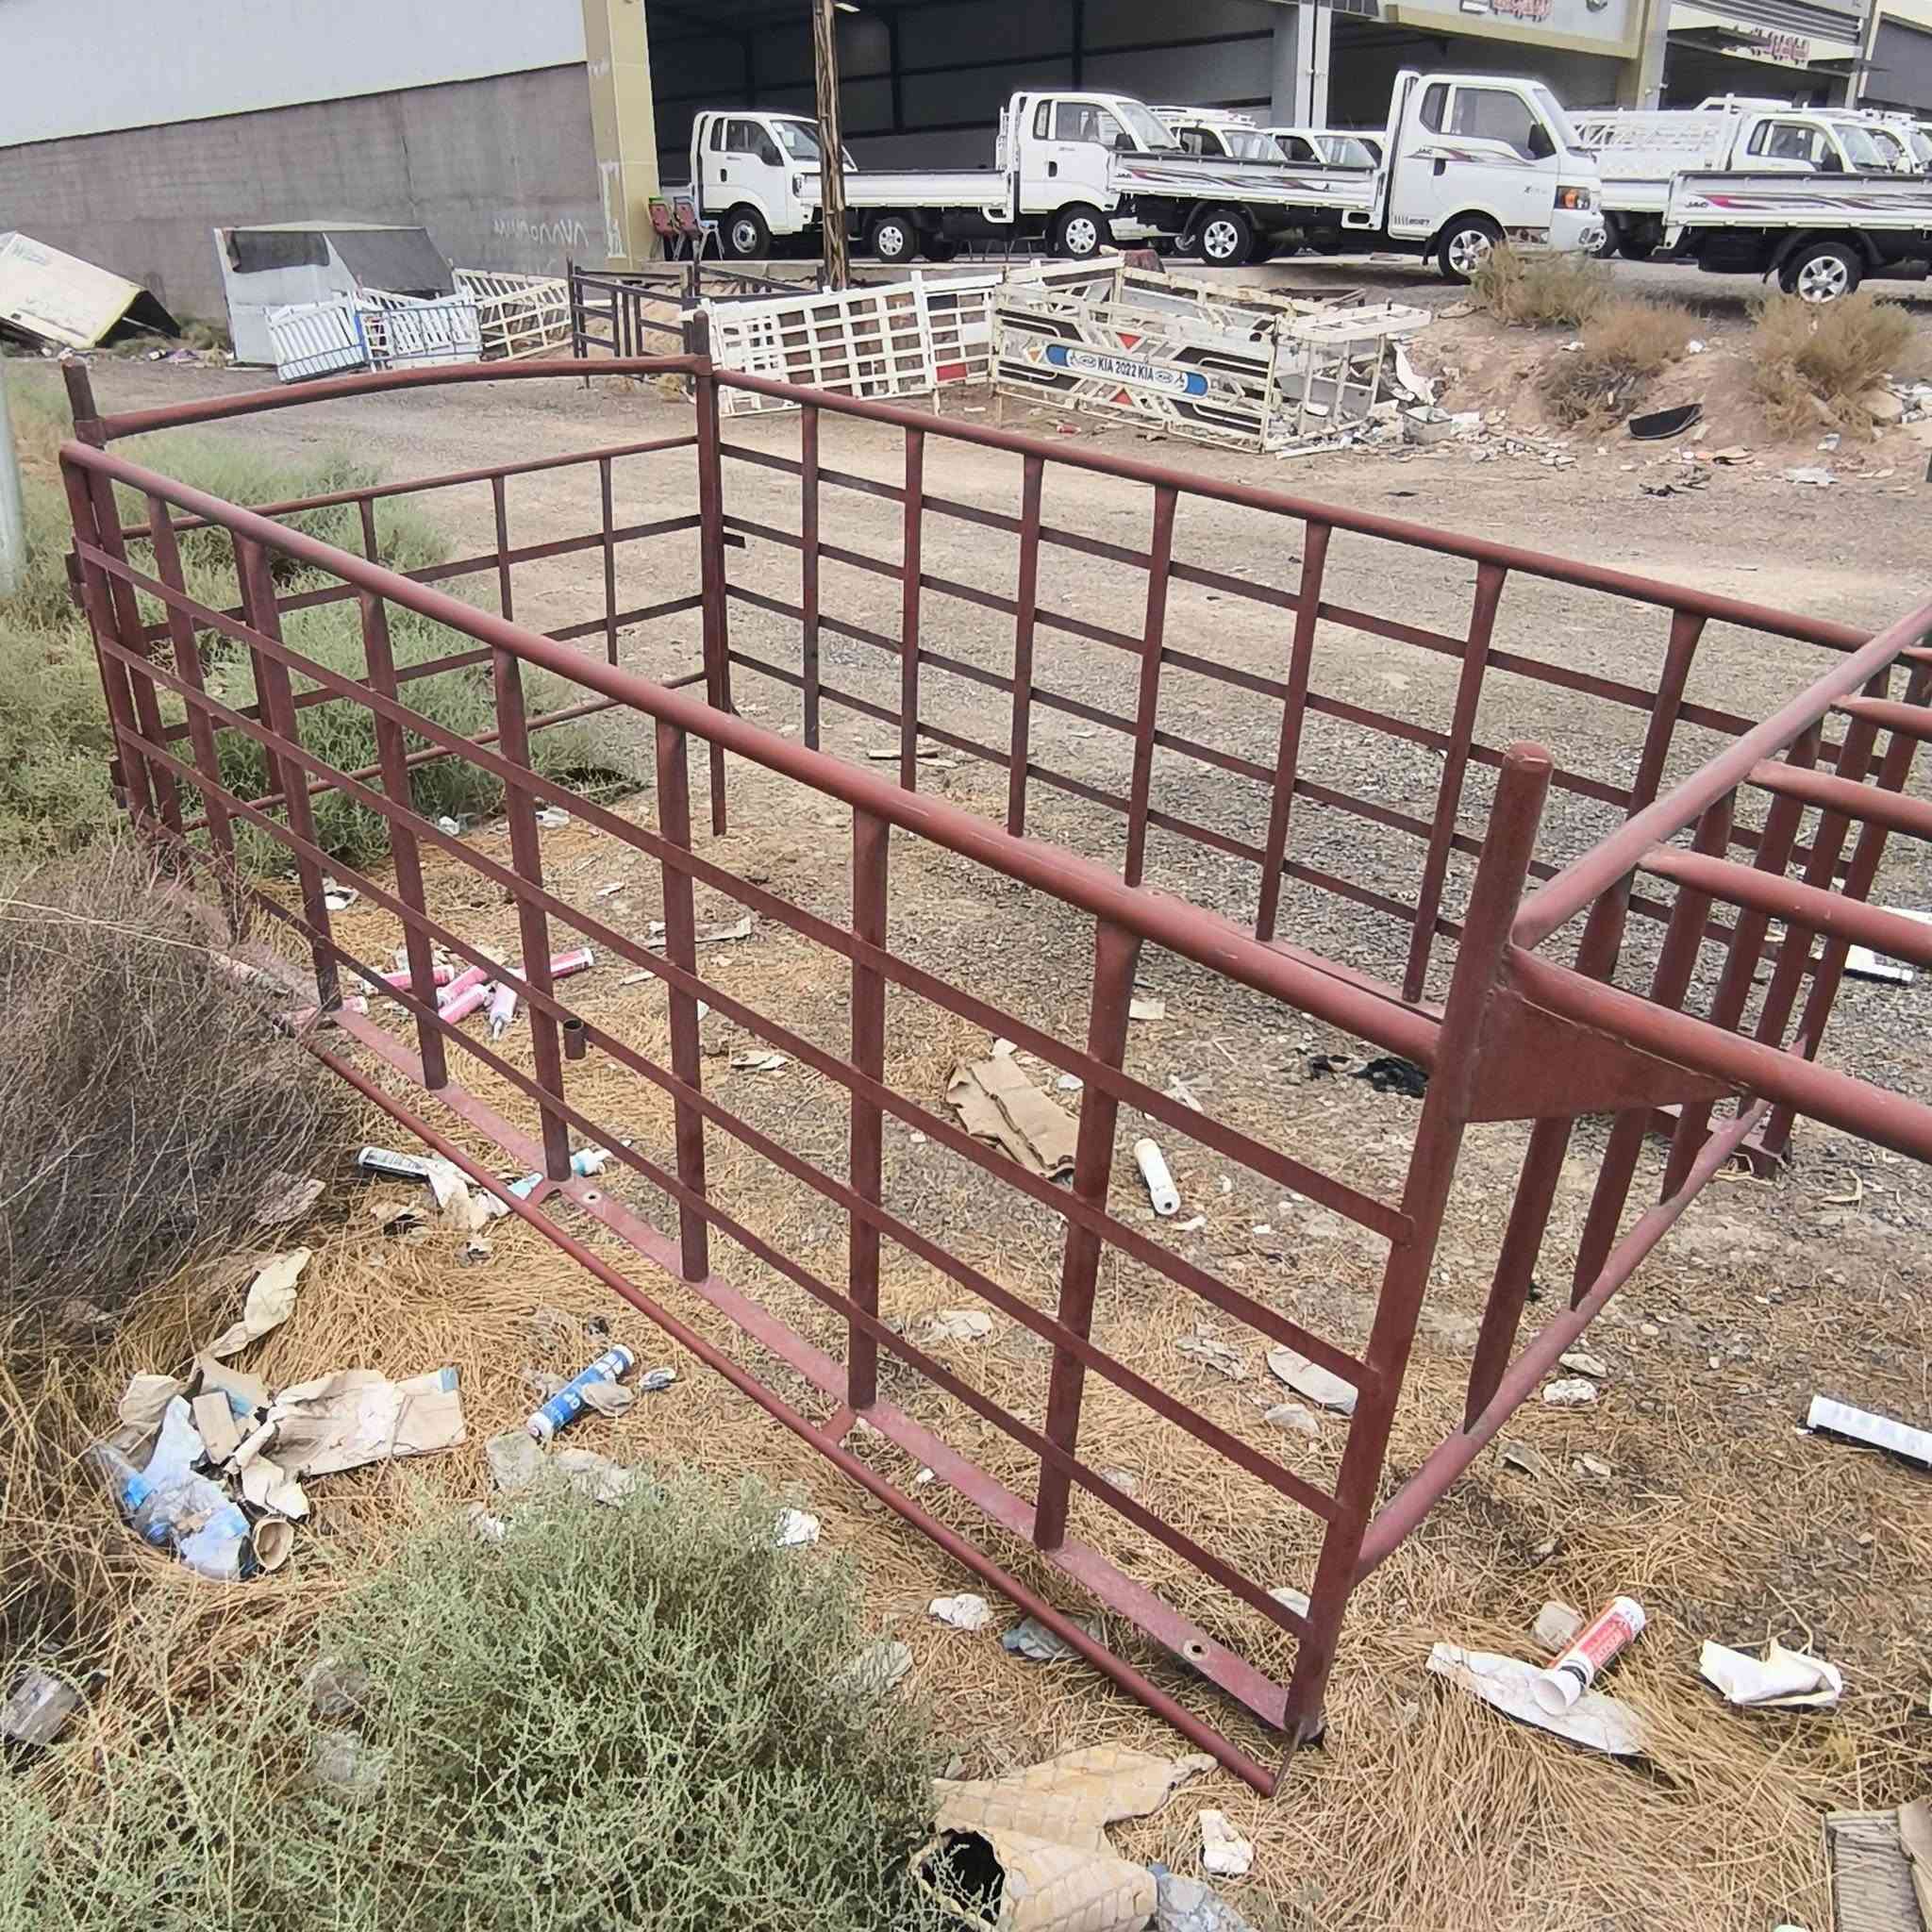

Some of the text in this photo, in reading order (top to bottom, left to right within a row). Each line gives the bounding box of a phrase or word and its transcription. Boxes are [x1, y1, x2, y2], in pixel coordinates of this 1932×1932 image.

[1097, 357, 1113, 372] KIA
[1115, 361, 1136, 377] 2022
[1138, 365, 1154, 381] KIA
